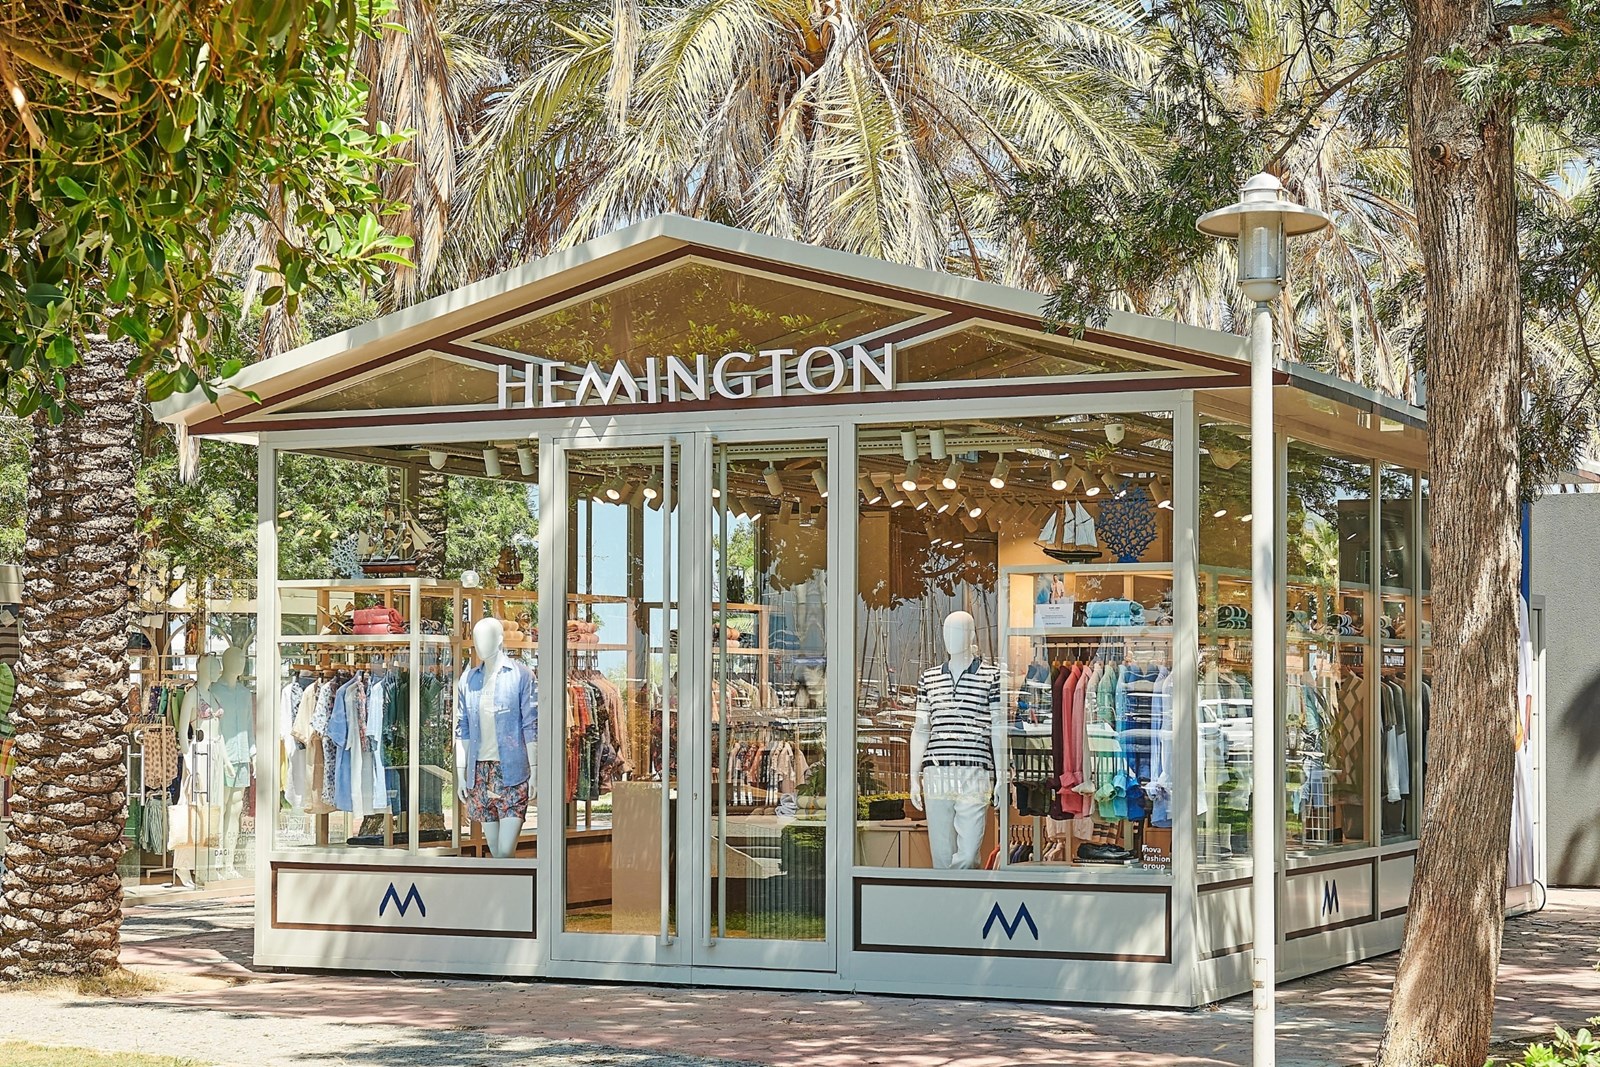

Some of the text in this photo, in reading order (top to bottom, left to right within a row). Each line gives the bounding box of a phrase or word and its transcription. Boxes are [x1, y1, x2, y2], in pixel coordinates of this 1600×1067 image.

[498, 342, 898, 409] HEMINGTON
[1143, 854, 1171, 862] fashion
[1143, 863, 1165, 871] group
